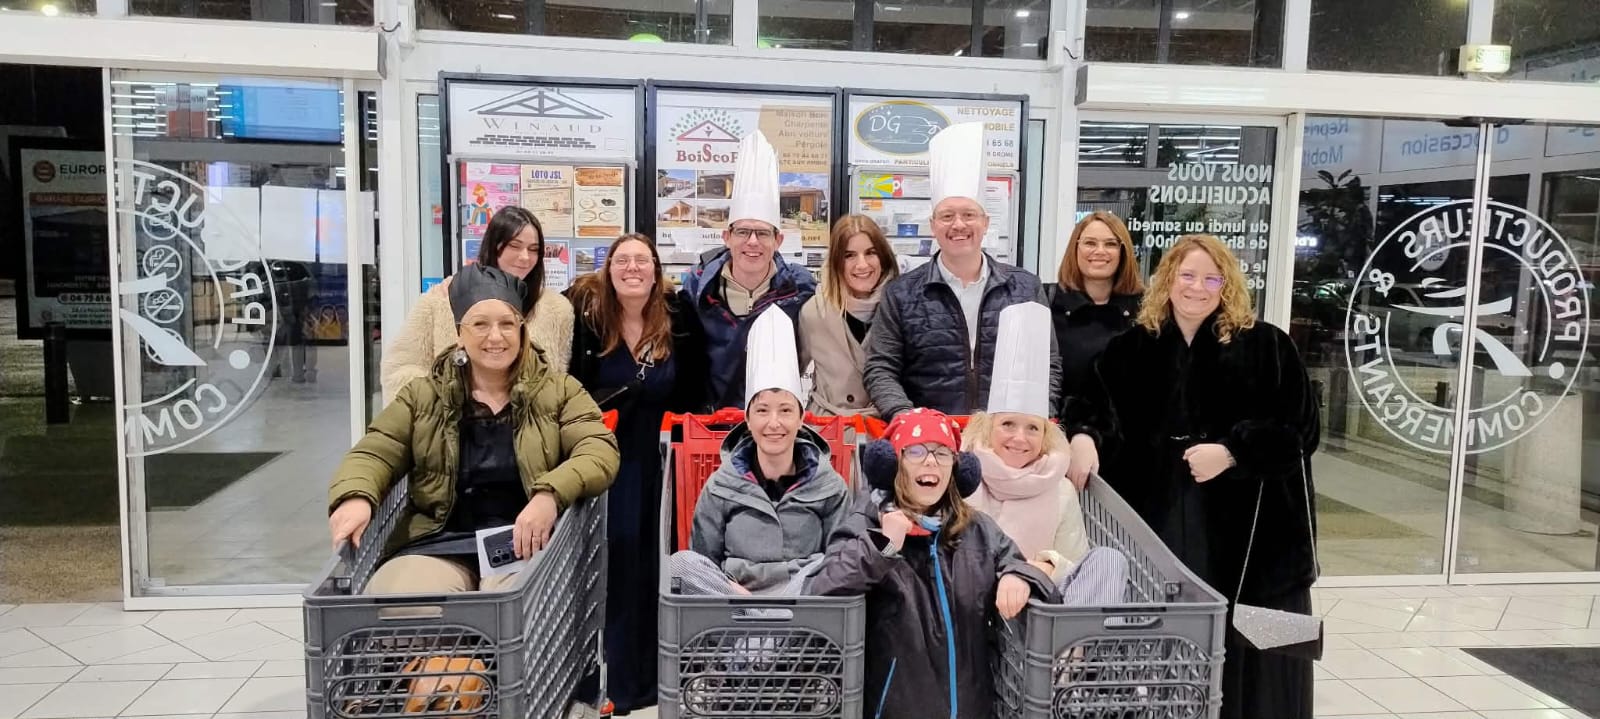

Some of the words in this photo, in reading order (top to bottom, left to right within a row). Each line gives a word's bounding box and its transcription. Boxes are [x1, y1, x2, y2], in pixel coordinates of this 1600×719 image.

[957, 107, 1015, 117] NETTOYAGE
[483, 117, 602, 134] WINAUD
[531, 170, 549, 179] LOTO
[550, 171, 562, 180] JSL
